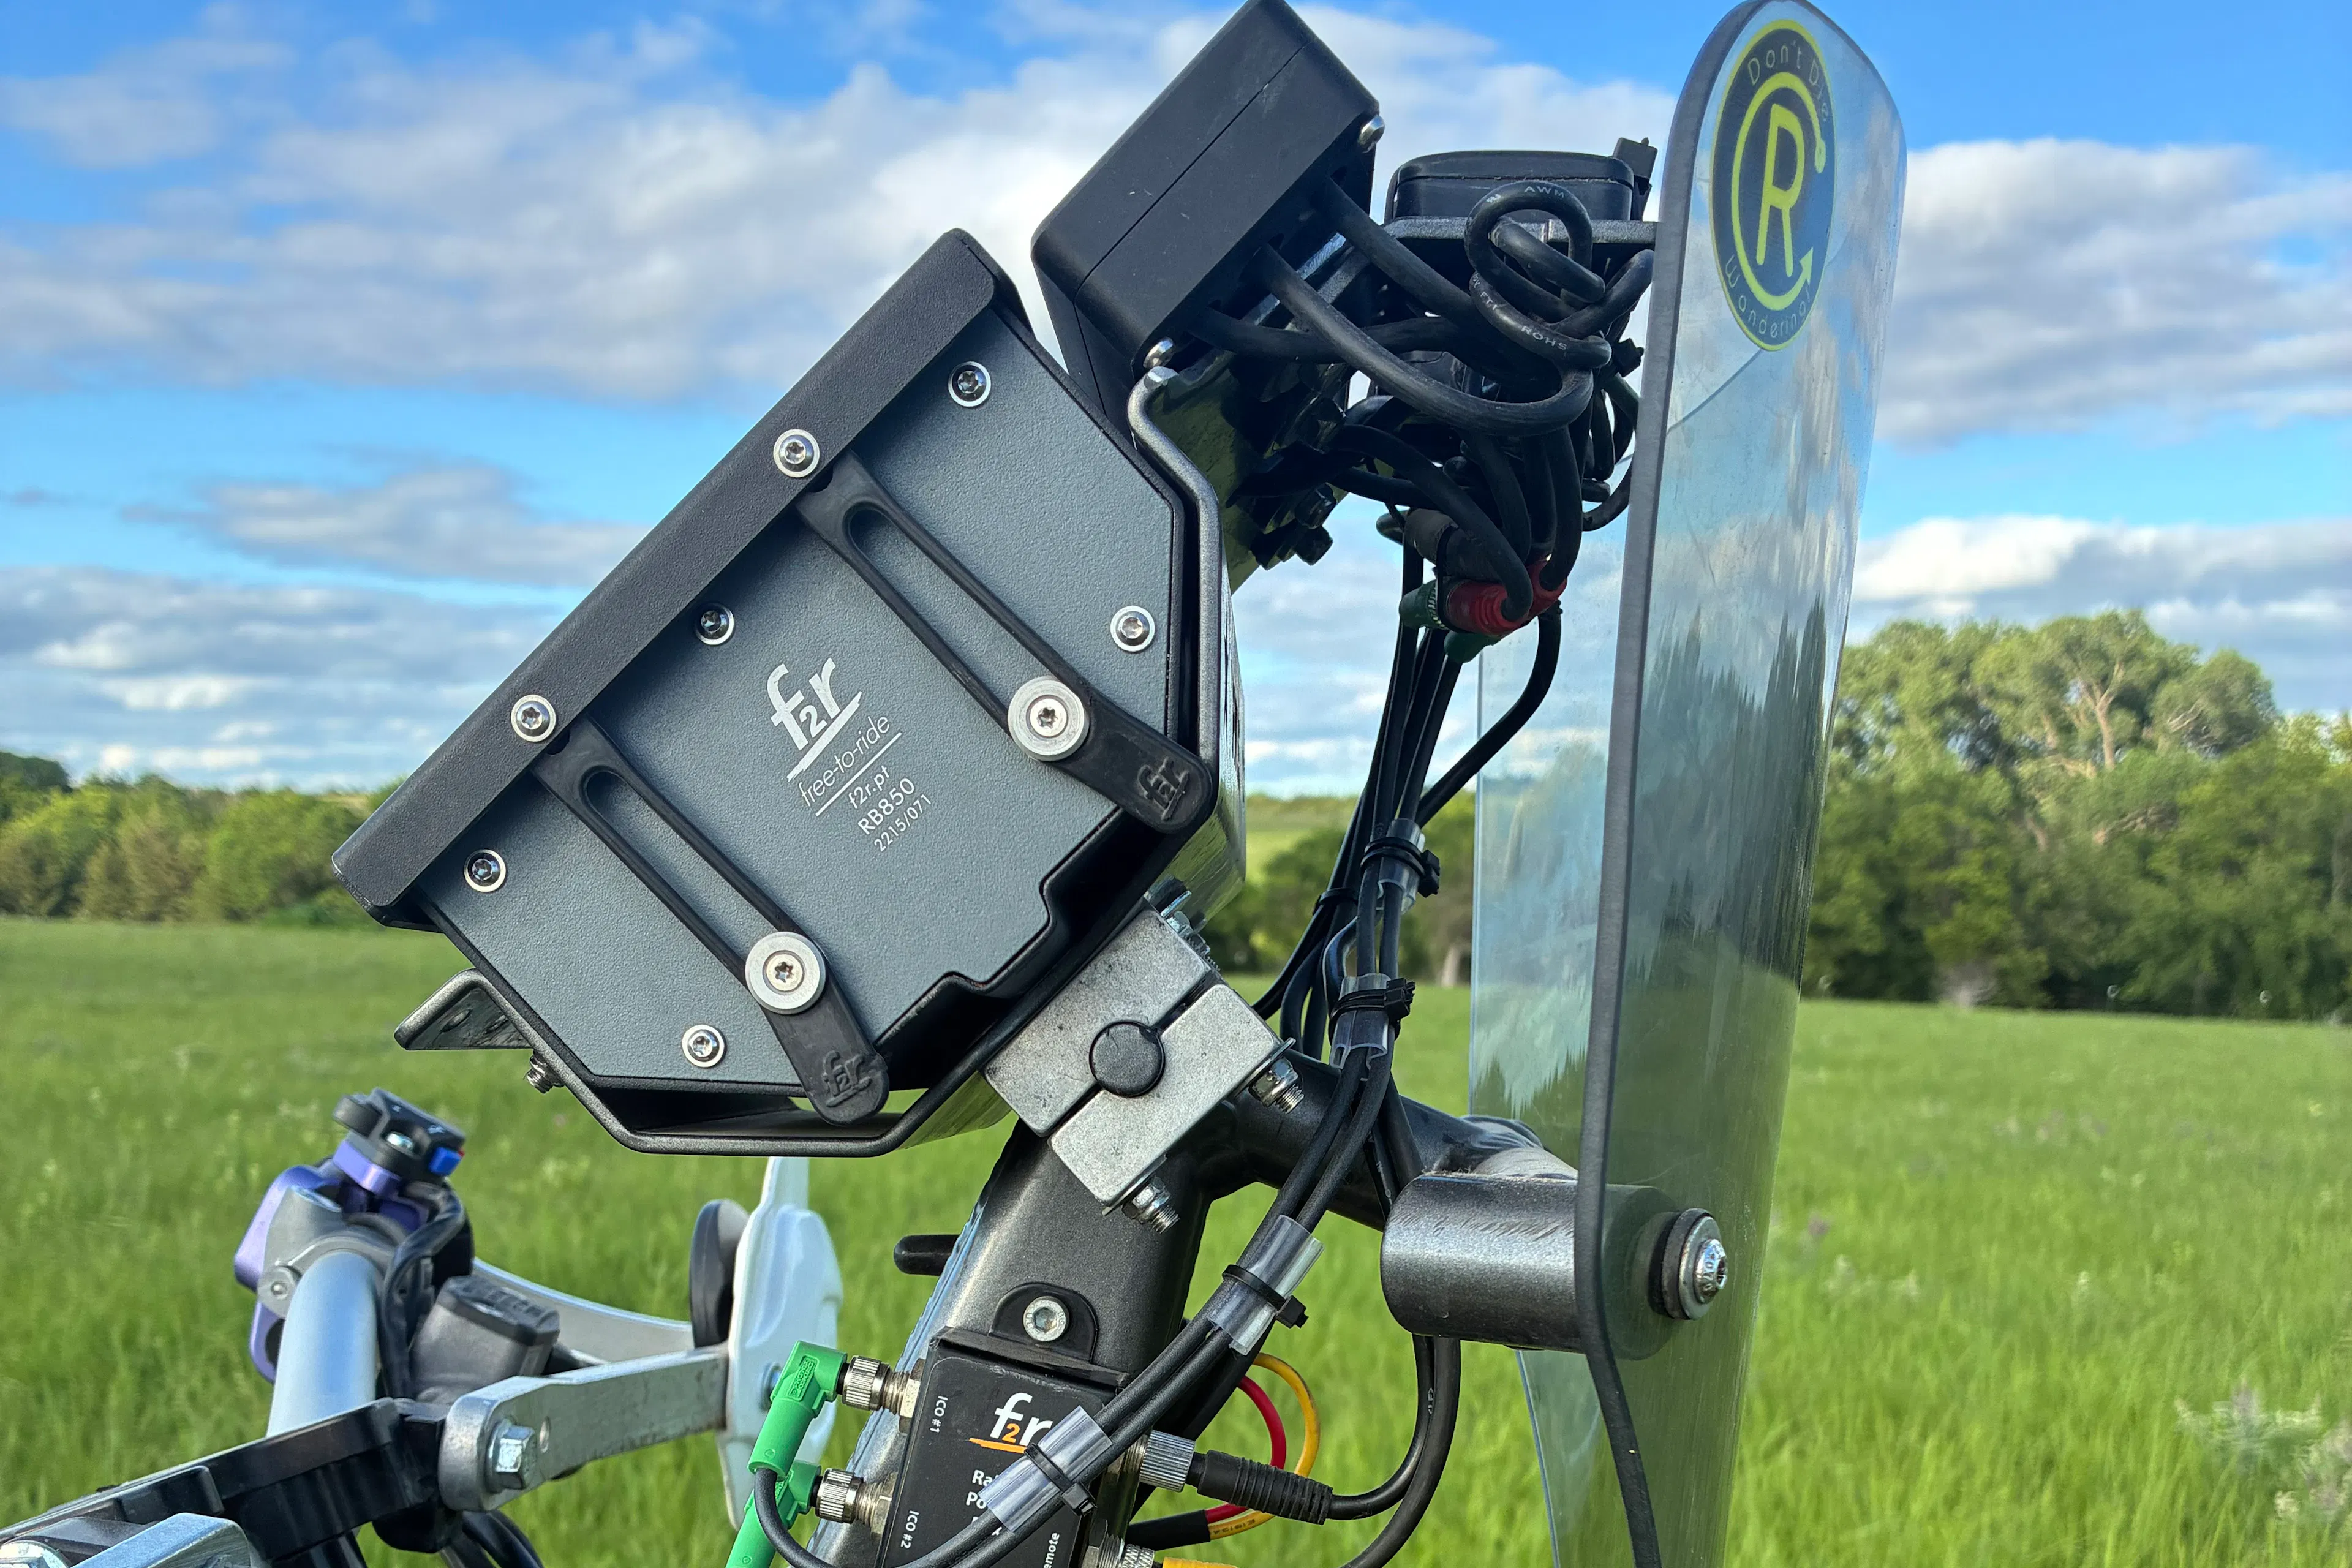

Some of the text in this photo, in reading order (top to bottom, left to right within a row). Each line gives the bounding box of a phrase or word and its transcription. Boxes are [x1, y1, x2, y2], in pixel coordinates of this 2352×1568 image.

[1524, 186, 1564, 198] AWM
[1755, 103, 1805, 277] R
[1521, 325, 1567, 350] ROHS
[767, 657, 841, 751] f2r
[798, 716, 890, 807] free-to-ride
[848, 764, 891, 809] f2r.pt
[858, 778, 915, 835] RB850
[873, 794, 932, 852] 2215/071
[930, 1395, 948, 1433] ICO #1
[972, 1469, 999, 1487] Ra
[966, 1491, 987, 1509] Po
[900, 1510, 919, 1549] ICO #2
[1043, 1532, 1060, 1568] emote
